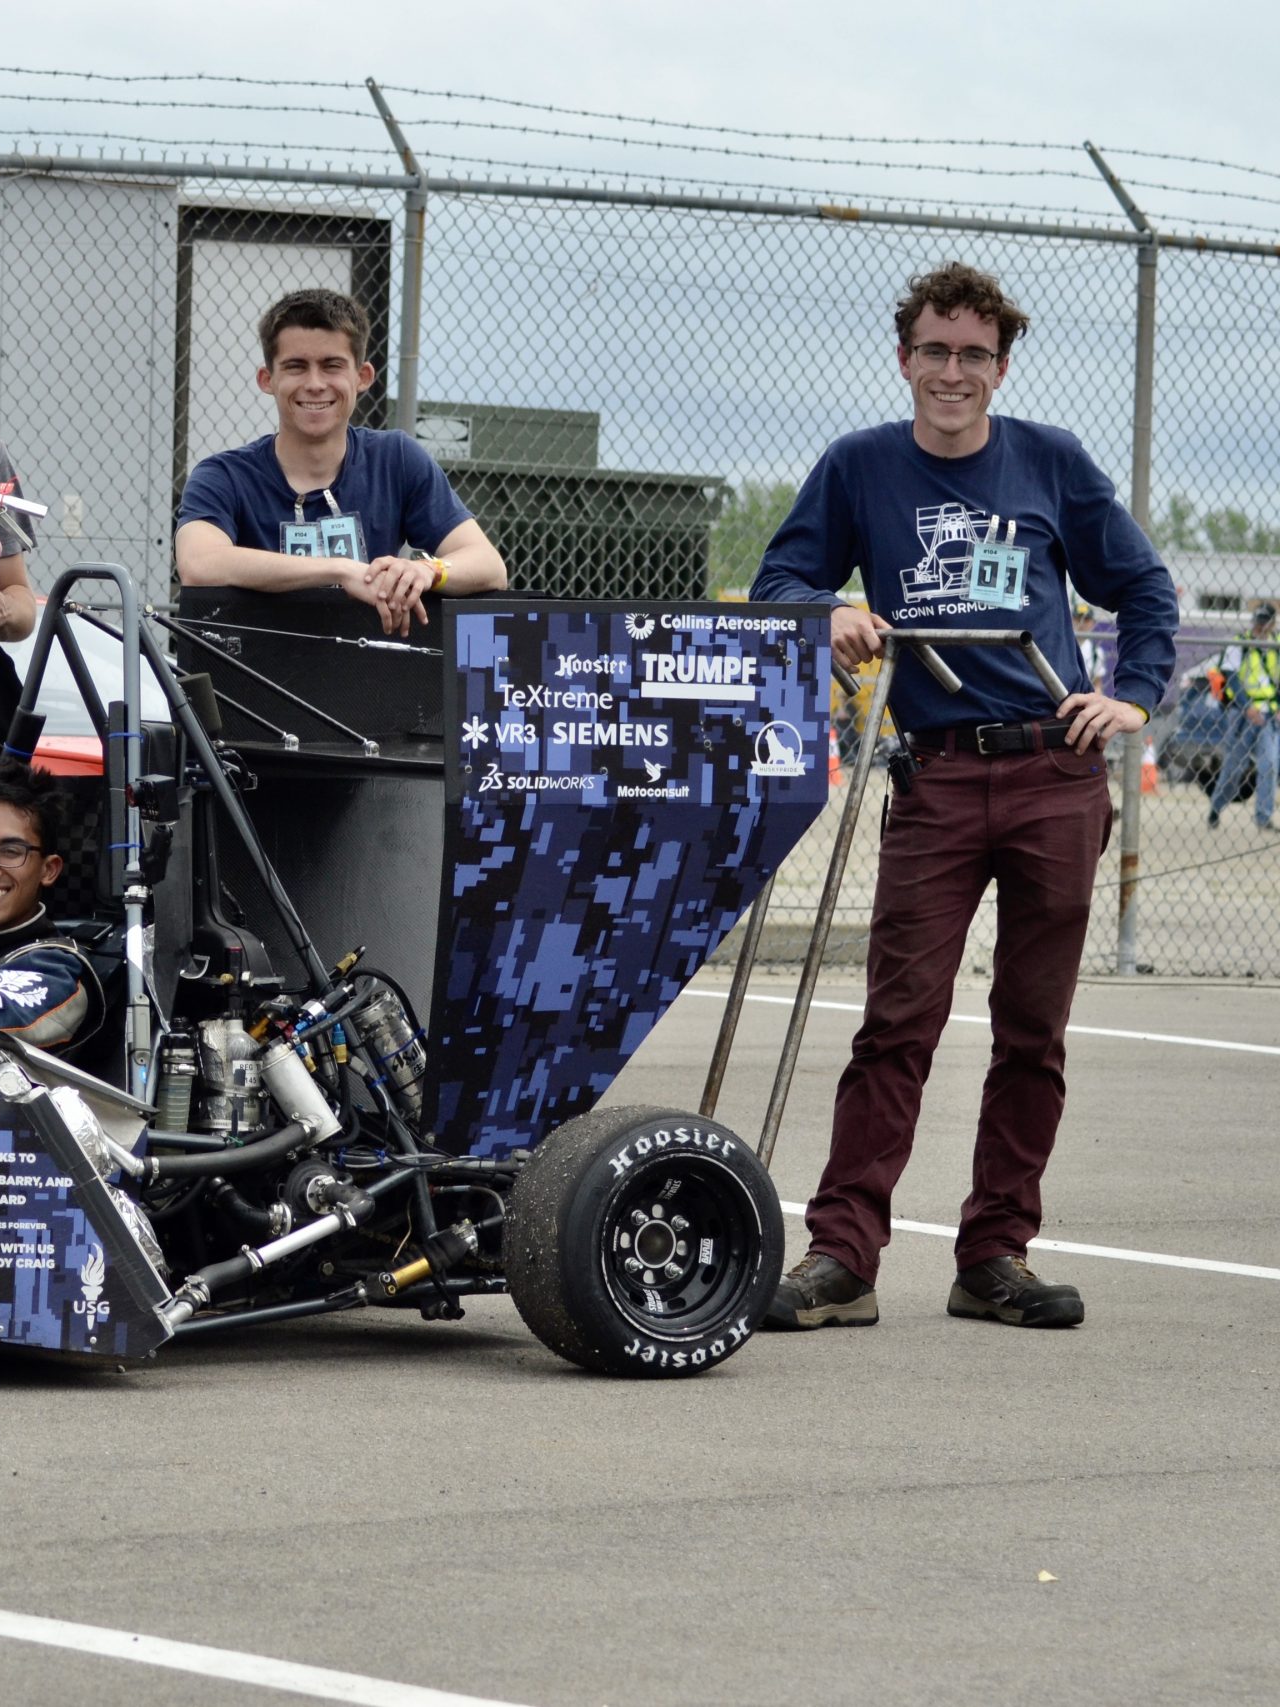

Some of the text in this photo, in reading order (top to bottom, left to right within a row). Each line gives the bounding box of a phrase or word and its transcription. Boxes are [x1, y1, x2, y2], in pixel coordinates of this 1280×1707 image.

[334, 539, 347, 556] 4
[983, 565, 992, 583] 1
[891, 601, 997, 620] UCONN FORMU
[660, 614, 797, 634] Collins Aerospace
[554, 653, 757, 685] Hoosier TRUMPF
[499, 684, 614, 710] TeXtreme
[494, 722, 670, 747] VR3 SIEMENS
[507, 775, 595, 790] SOLIDWORKS
[617, 785, 690, 798] Motoconsult
[19, 1152, 36, 1164] TO
[608, 1127, 737, 1179] Hoosier
[45, 1177, 73, 1188] AND
[8, 1222, 47, 1230] FOREVER
[0, 1243, 36, 1254] WITH
[37, 1244, 55, 1255] US
[15, 1258, 55, 1269] CRAIG
[73, 1300, 110, 1315] USG
[624, 1315, 752, 1369] Hoosier
